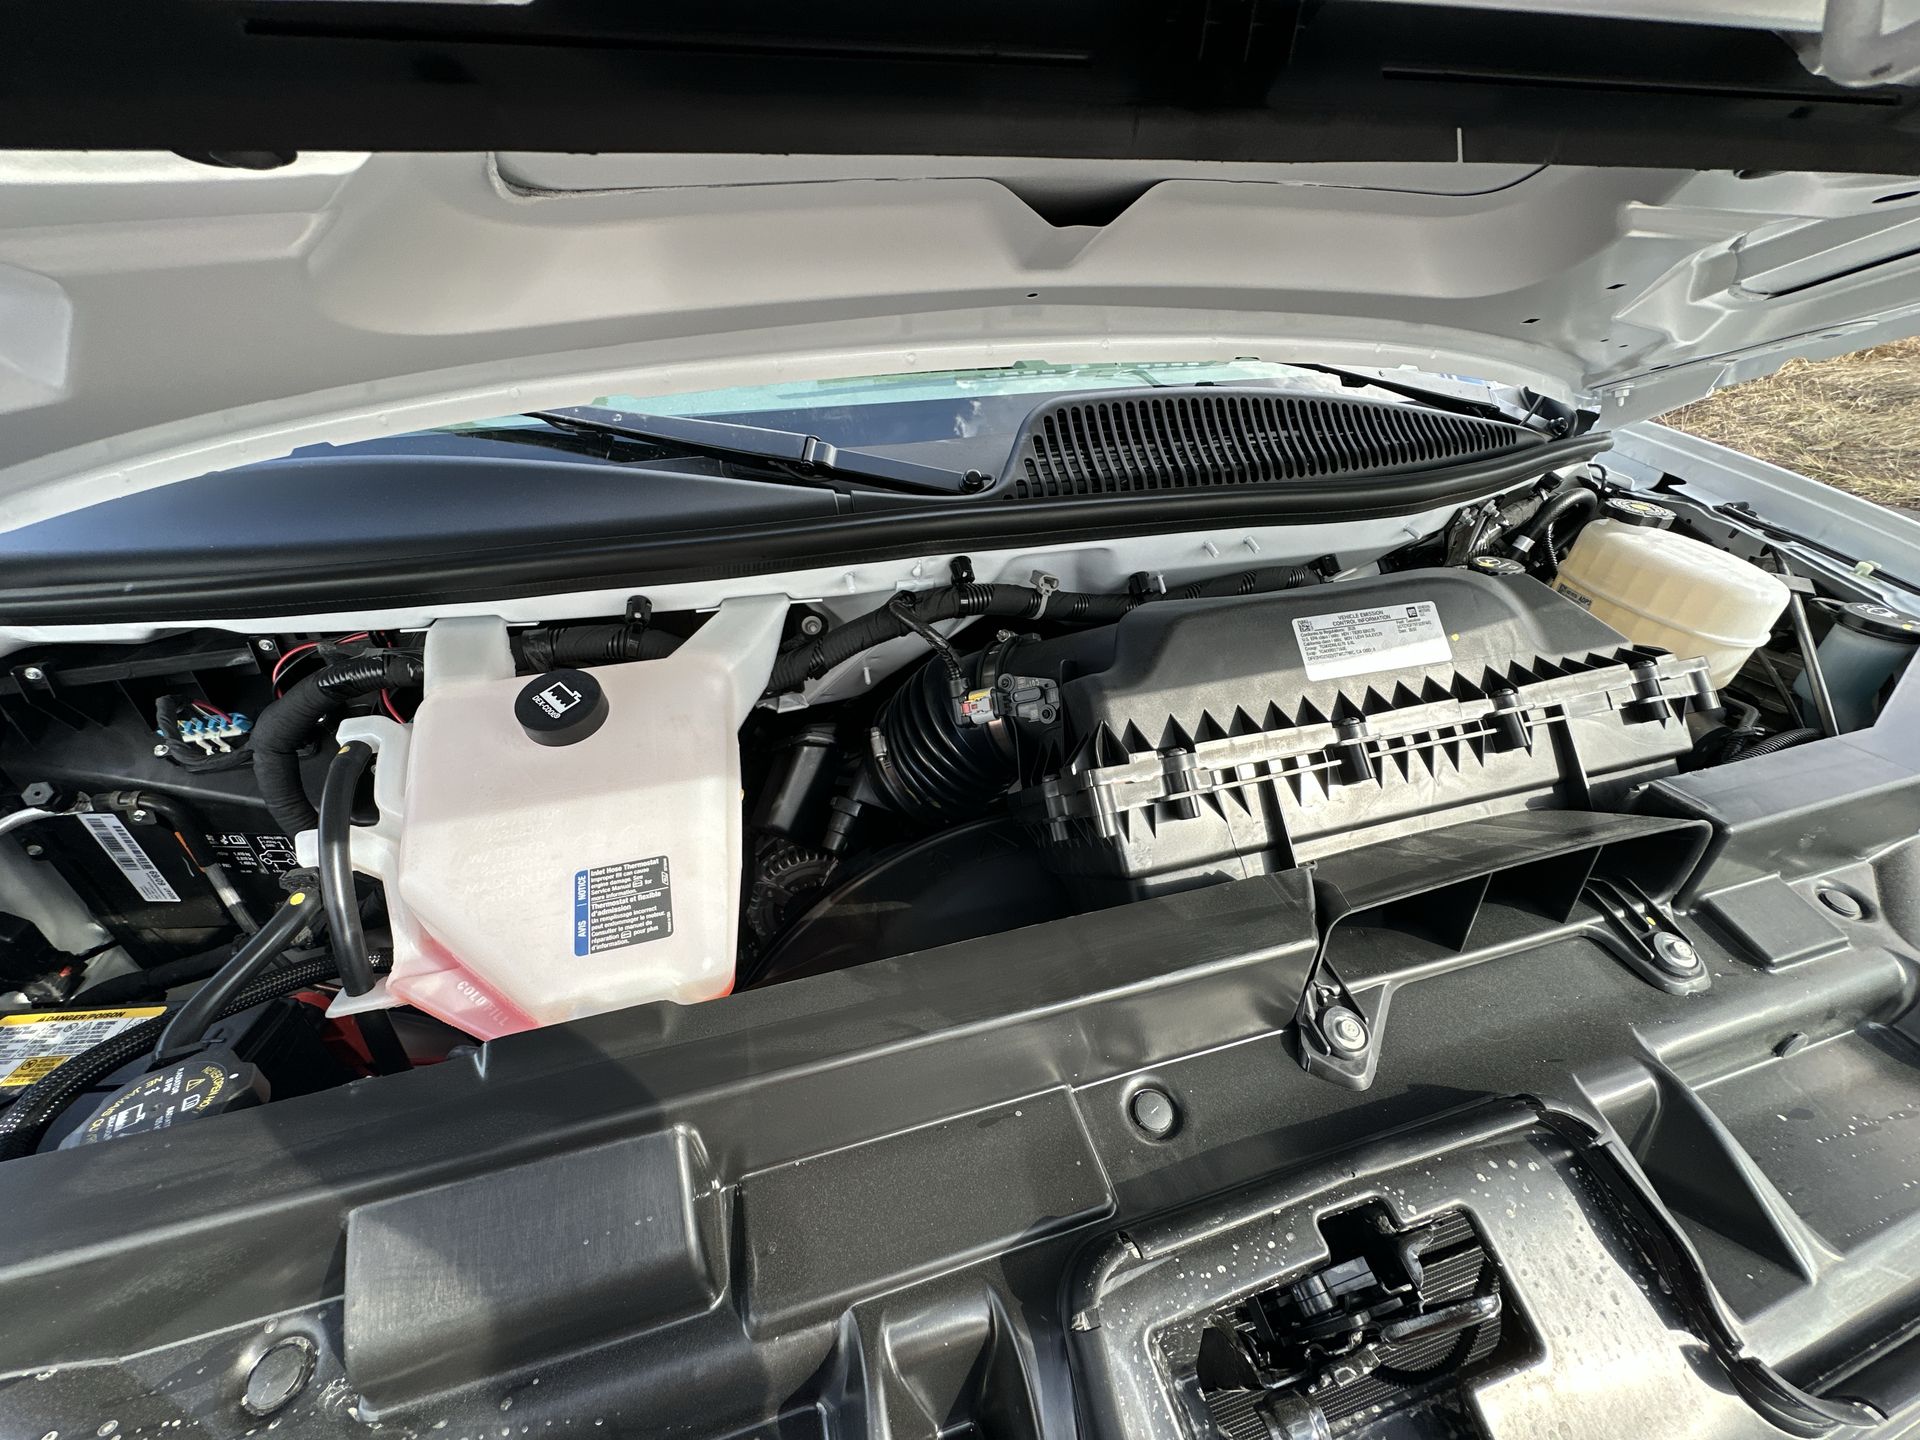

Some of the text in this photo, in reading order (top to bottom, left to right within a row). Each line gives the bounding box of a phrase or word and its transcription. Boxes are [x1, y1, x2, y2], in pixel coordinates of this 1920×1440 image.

[1358, 615, 1391, 623] INFORMATION
[591, 859, 659, 876] Inlet Hose Thermostat
[591, 874, 614, 883] Improper
[591, 881, 609, 889] engine
[577, 875, 586, 900] NOTICE
[591, 888, 611, 896] Service
[612, 883, 631, 891] Manual
[591, 897, 628, 909] Thermostat
[638, 891, 662, 901] flexible
[591, 905, 631, 917] d'admission
[634, 906, 657, 915] incorrect
[578, 920, 586, 937] AVIS
[591, 923, 604, 931] peut
[591, 927, 617, 937] Consulter
[625, 922, 645, 930] manuel
[633, 928, 646, 936] pour
[456, 980, 511, 1026] COLD FILL
[145, 1076, 164, 1088] NE
[170, 1067, 185, 1095] RADIATOR
[207, 1078, 225, 1096] OPEN
[102, 1087, 142, 1117] JAMAIS
